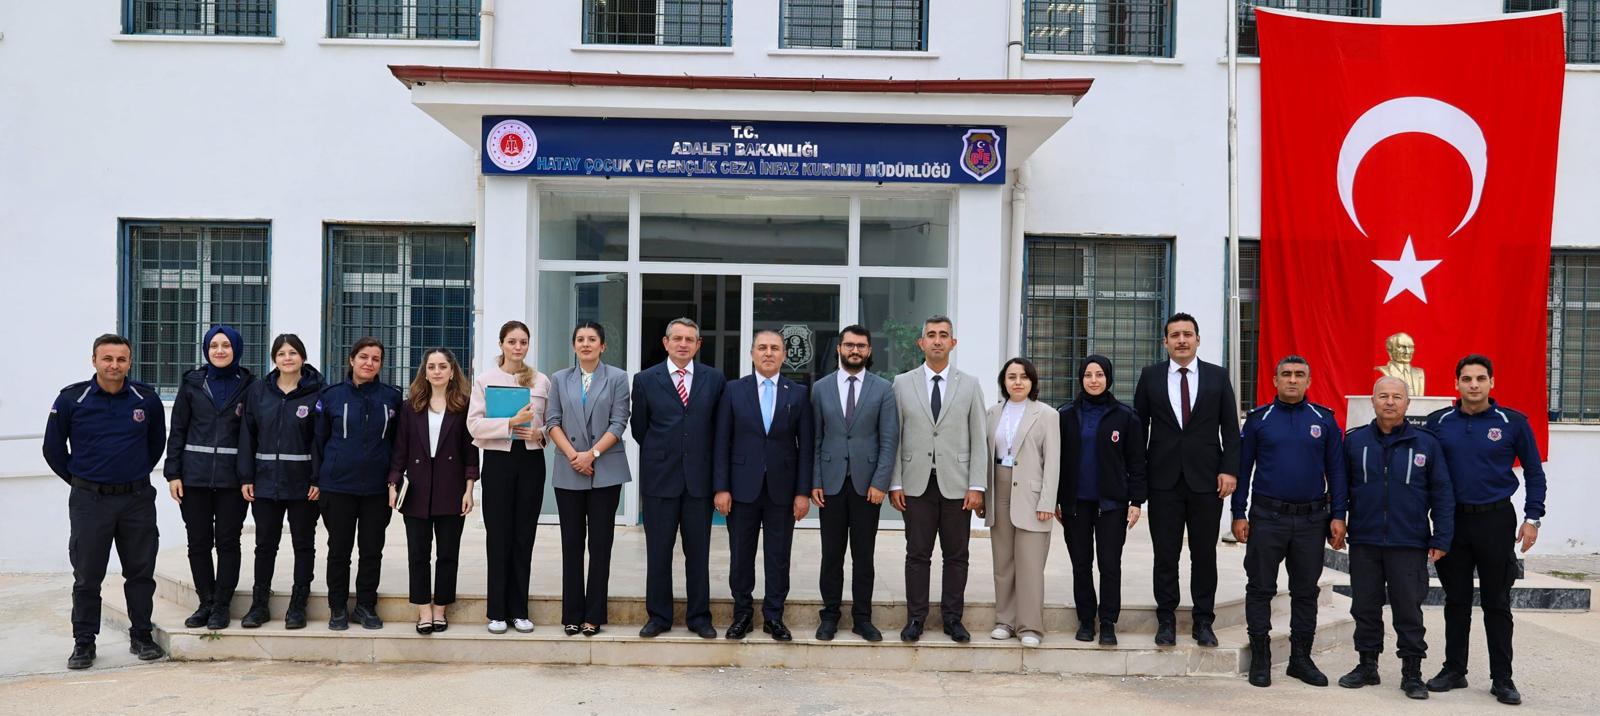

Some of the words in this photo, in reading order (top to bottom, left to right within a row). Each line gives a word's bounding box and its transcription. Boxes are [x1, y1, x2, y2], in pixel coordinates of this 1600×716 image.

[731, 125, 759, 139] T.C.
[671, 141, 731, 156] ADALET
[734, 141, 818, 158] BAKANLIĞI
[537, 156, 581, 171] HATAY
[584, 158, 632, 175] ÇOCUK
[635, 159, 654, 173] VE
[657, 158, 717, 177] GENÇLİK
[720, 160, 756, 175] CEZA
[759, 158, 799, 176] İNFAZ
[802, 162, 861, 177] KURUMU
[865, 161, 951, 179] MÜDÜRLÜĞÜ
